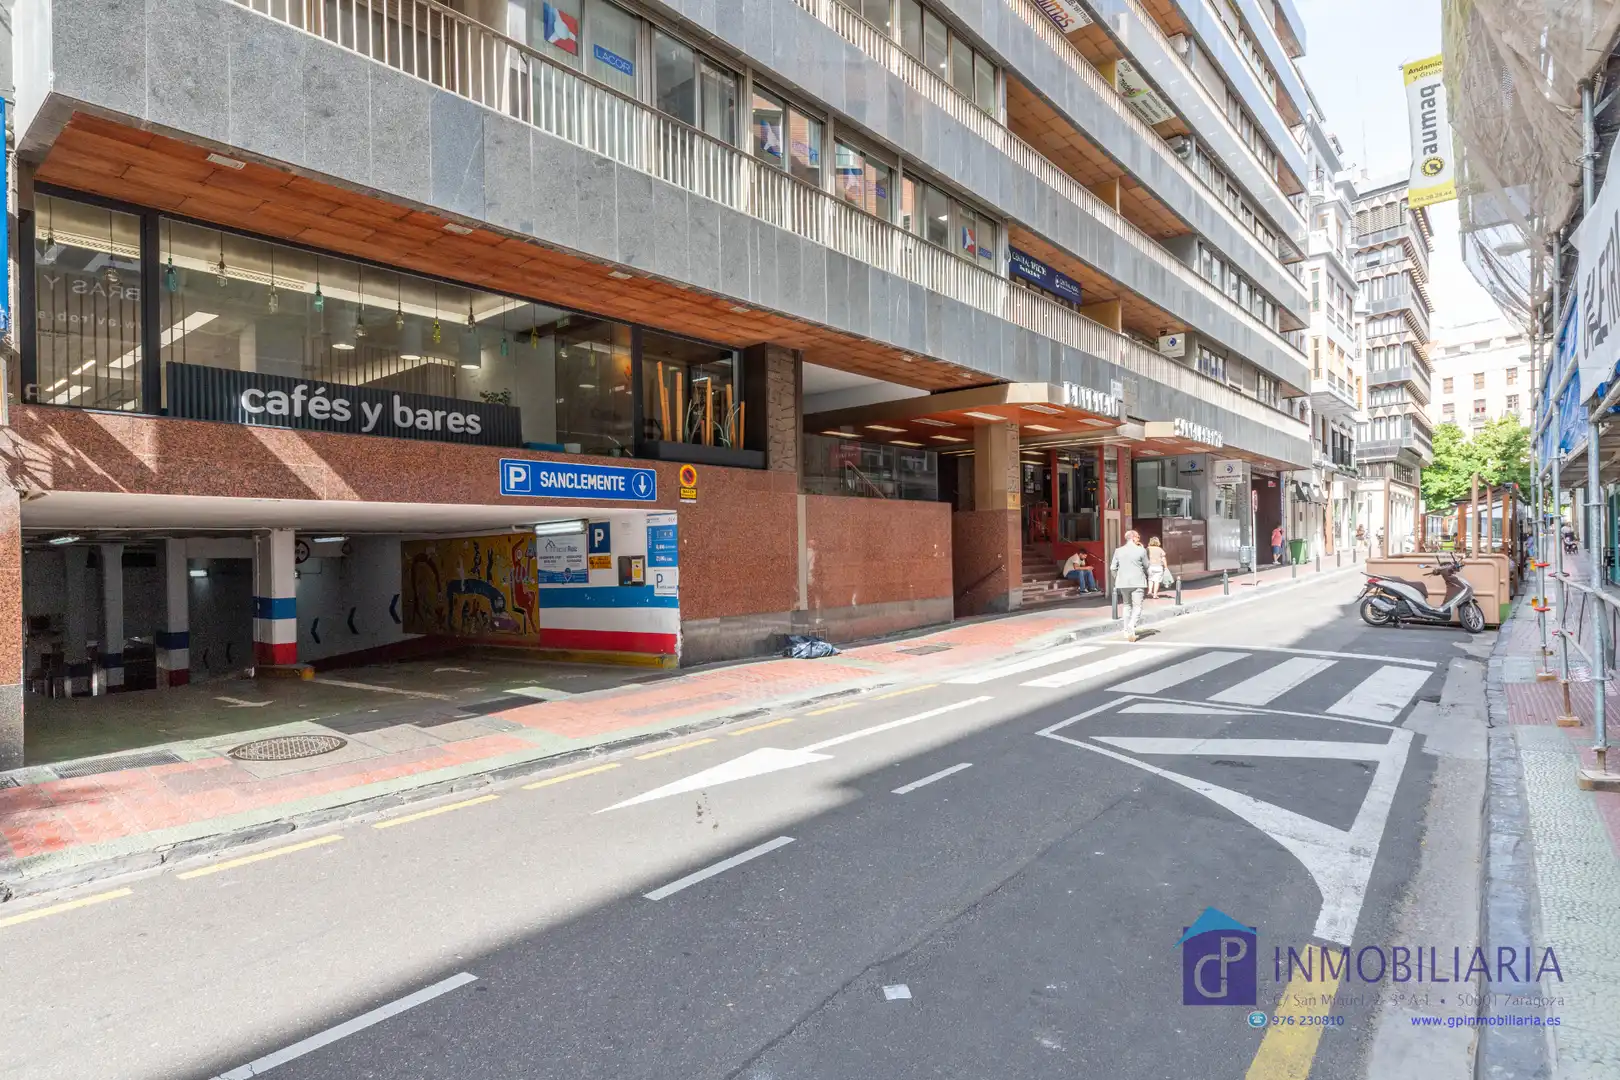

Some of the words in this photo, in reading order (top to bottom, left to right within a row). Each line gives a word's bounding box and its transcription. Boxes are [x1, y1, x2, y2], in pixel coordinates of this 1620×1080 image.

[595, 47, 632, 75] LACOR
[1408, 61, 1442, 75] Andamio
[1420, 82, 1441, 156] aumaq
[241, 384, 351, 422] cafés
[361, 401, 383, 433] y
[393, 394, 482, 436] bares
[509, 466, 527, 490] P
[540, 471, 626, 492] SANCLEMENTE
[594, 528, 604, 548] P
